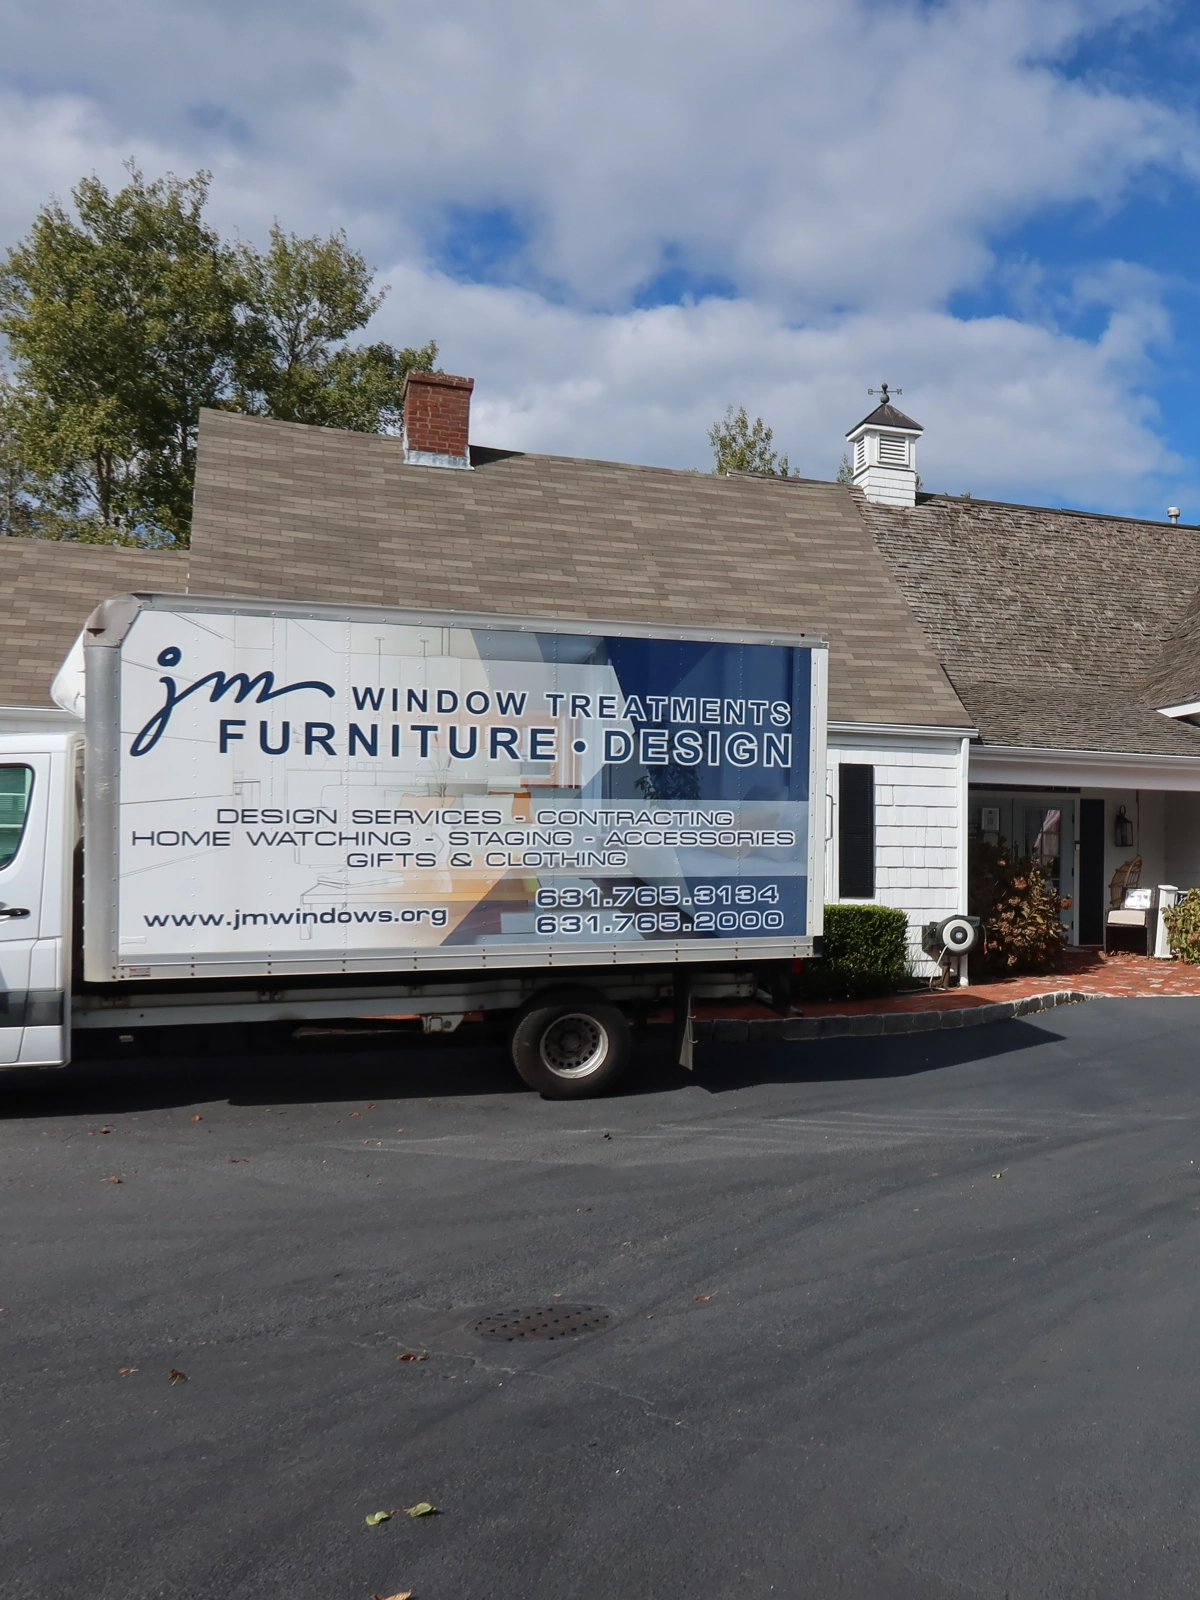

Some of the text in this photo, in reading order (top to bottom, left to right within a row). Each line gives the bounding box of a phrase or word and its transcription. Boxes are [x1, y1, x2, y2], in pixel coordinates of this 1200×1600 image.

[130, 646, 335, 756] jm
[352, 686, 791, 727] WINDOW TREATMENTS
[219, 719, 556, 760] FURNITURE
[603, 727, 792, 768] DESIGN
[217, 809, 337, 824] DESIGN
[352, 810, 501, 825] SERVICES
[537, 811, 734, 826] CONTRACTING
[132, 831, 231, 846] HOME
[246, 831, 411, 846] WATCHING
[449, 831, 572, 846] STAGING
[606, 830, 795, 846] ACCESSORIES
[347, 852, 628, 867] GIFTS & CLOTHING
[536, 885, 779, 908] 631.765.3134
[144, 908, 447, 930] www.jmwindows.org
[536, 911, 784, 934] 631.765.2000
